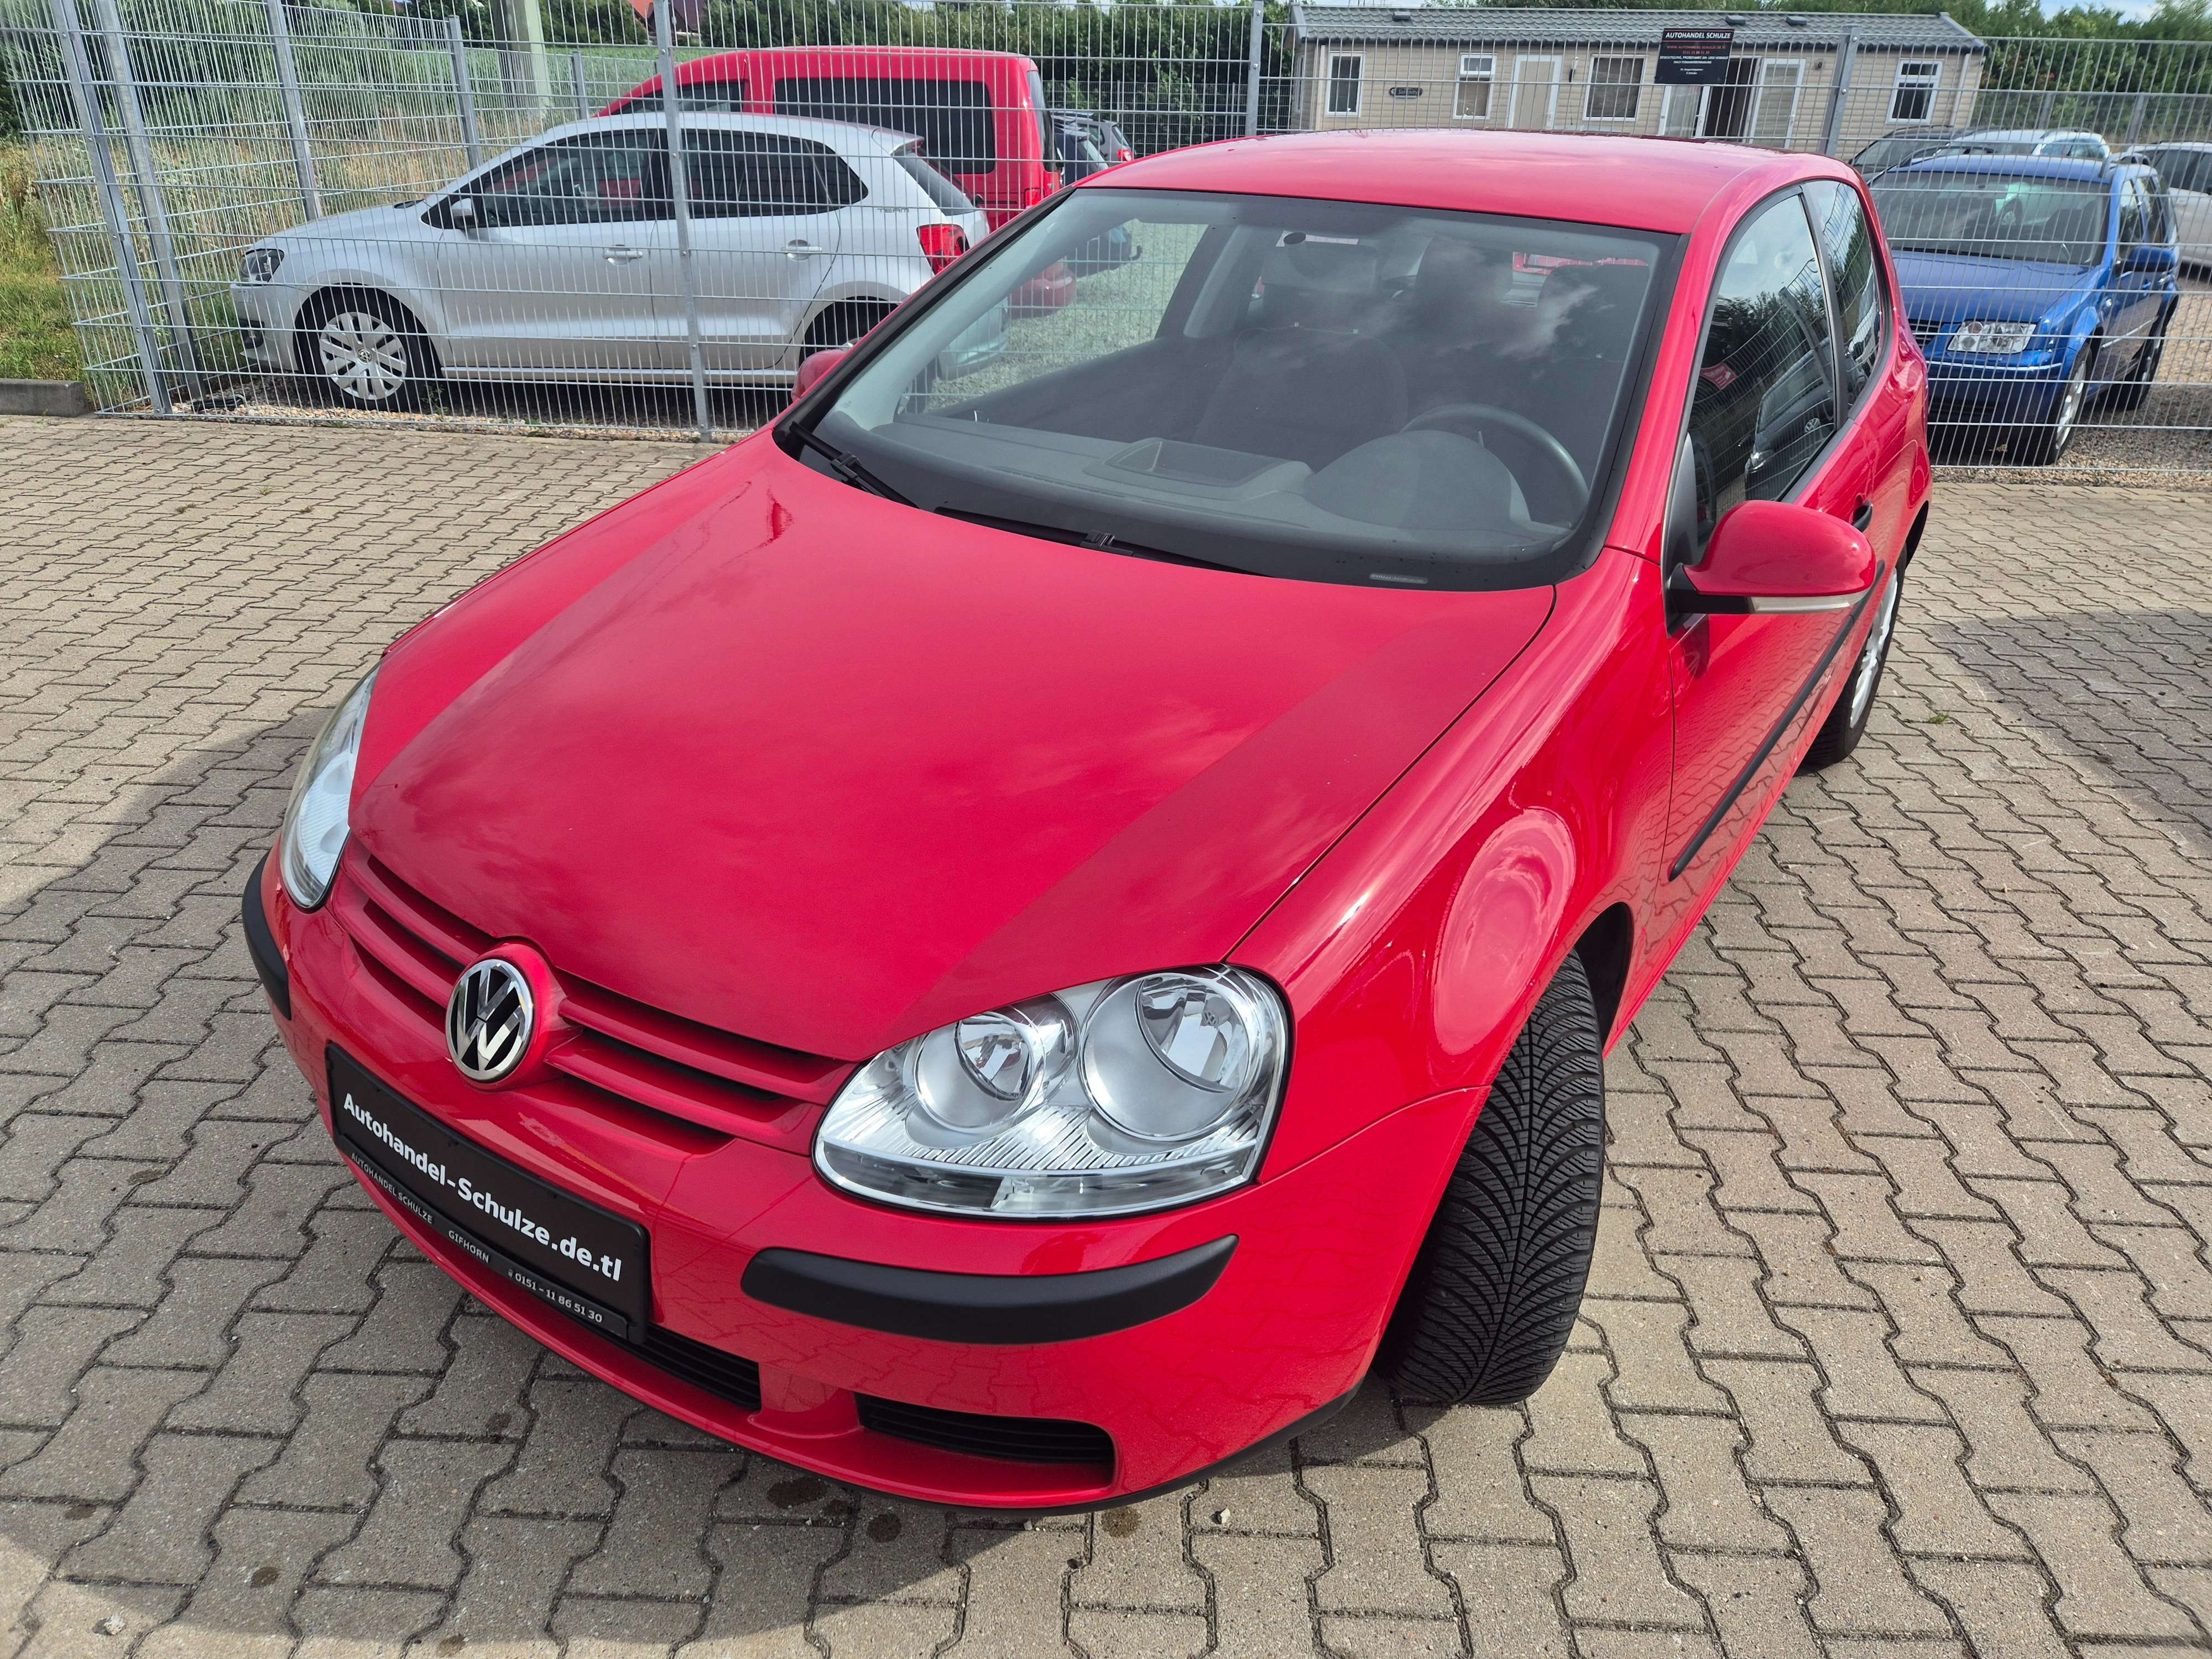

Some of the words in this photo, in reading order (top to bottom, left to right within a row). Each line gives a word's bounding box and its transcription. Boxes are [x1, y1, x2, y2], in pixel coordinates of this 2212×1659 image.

[448, 963, 530, 1078] VW
[343, 1093, 622, 1281] Autohandel-Schulze.de.tl
[351, 1153, 397, 1196] AUTOHANDEL
[398, 1192, 434, 1224] SCHULZE
[448, 1230, 489, 1264] GIFHORN
[515, 1272, 537, 1291] 0151
[546, 1289, 556, 1301] 11
[558, 1296, 572, 1308] 86
[574, 1303, 586, 1316] 51
[588, 1310, 603, 1323] 30
